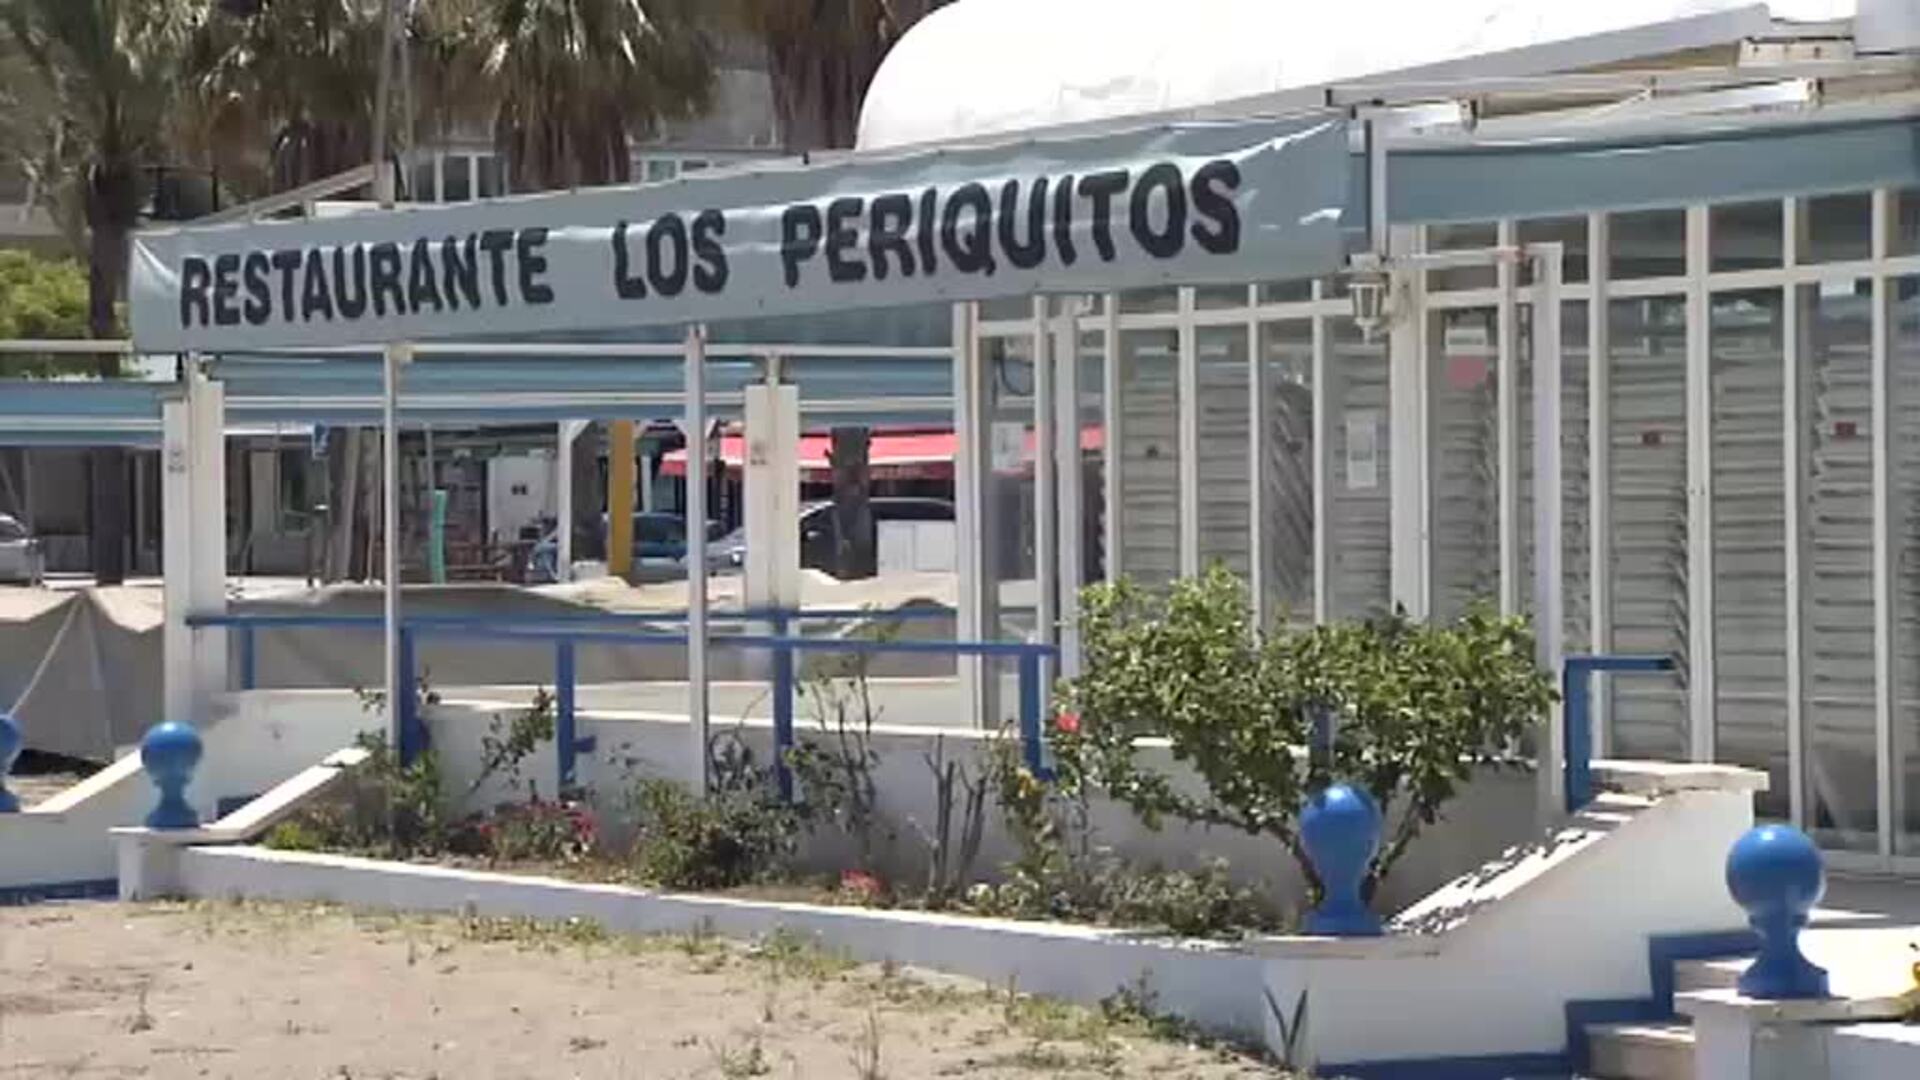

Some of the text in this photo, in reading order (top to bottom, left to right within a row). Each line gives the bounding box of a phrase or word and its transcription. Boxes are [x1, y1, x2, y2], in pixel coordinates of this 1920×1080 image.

[180, 159, 1242, 328] RESTAURANTE LOS PERIQUITOS
